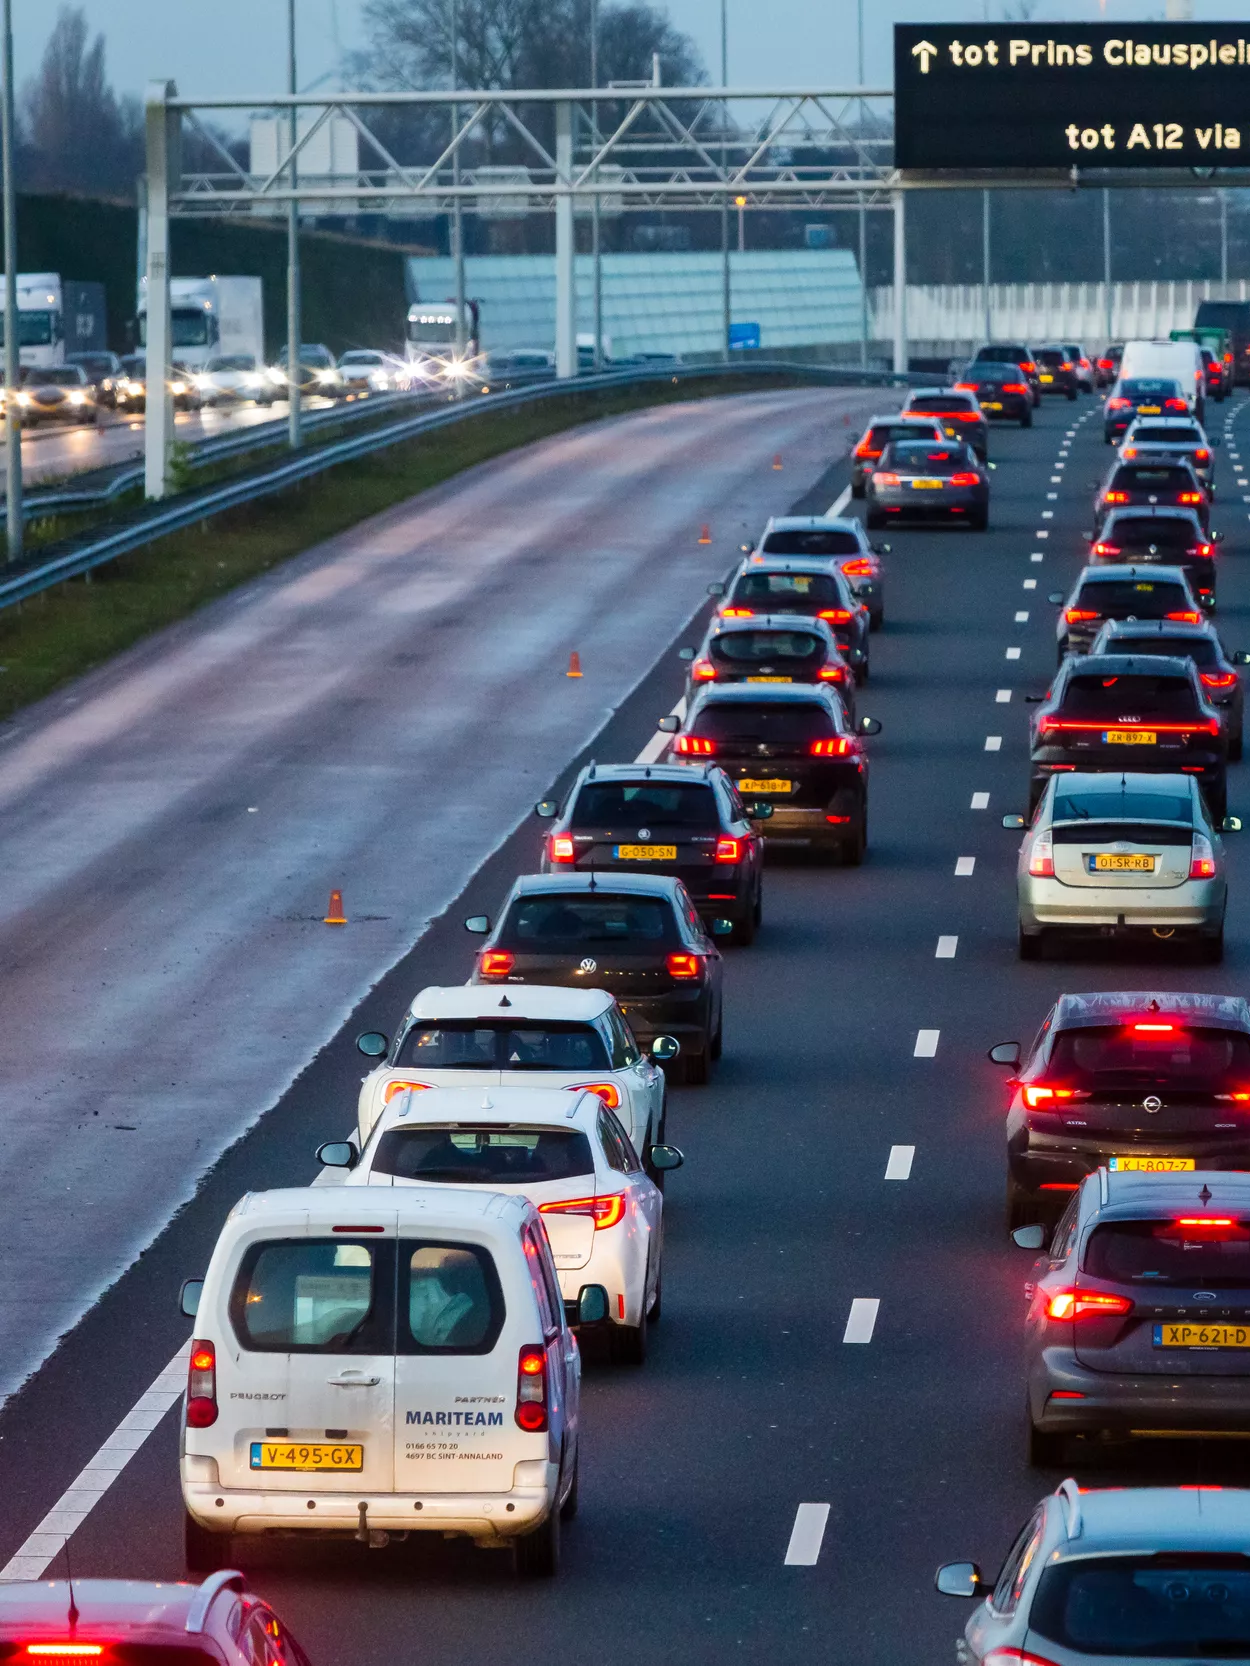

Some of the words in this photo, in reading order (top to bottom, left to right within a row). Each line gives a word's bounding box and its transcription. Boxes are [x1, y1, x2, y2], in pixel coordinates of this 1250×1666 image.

[950, 40, 998, 66] tot
[1009, 40, 1093, 66] Prins
[1066, 124, 1115, 149] tot
[1127, 124, 1183, 149] A12
[1196, 124, 1240, 149] via
[621, 847, 674, 858] G-050-SN
[1100, 858, 1150, 868] 01-SR-RB
[1169, 1327, 1247, 1343] XP-621-D
[230, 1392, 287, 1401] PEUGEOT
[454, 1396, 506, 1404] PARTNER
[405, 1410, 503, 1426] MARITEAM
[405, 1442, 425, 1450] 0166
[426, 1442, 436, 1450] 65
[438, 1442, 448, 1450] 70
[449, 1442, 459, 1450] 20
[267, 1447, 355, 1464] V-495-GX
[405, 1452, 425, 1460] 4697
[426, 1452, 437, 1460] BC
[438, 1452, 503, 1460] SINT-ANNALAND
